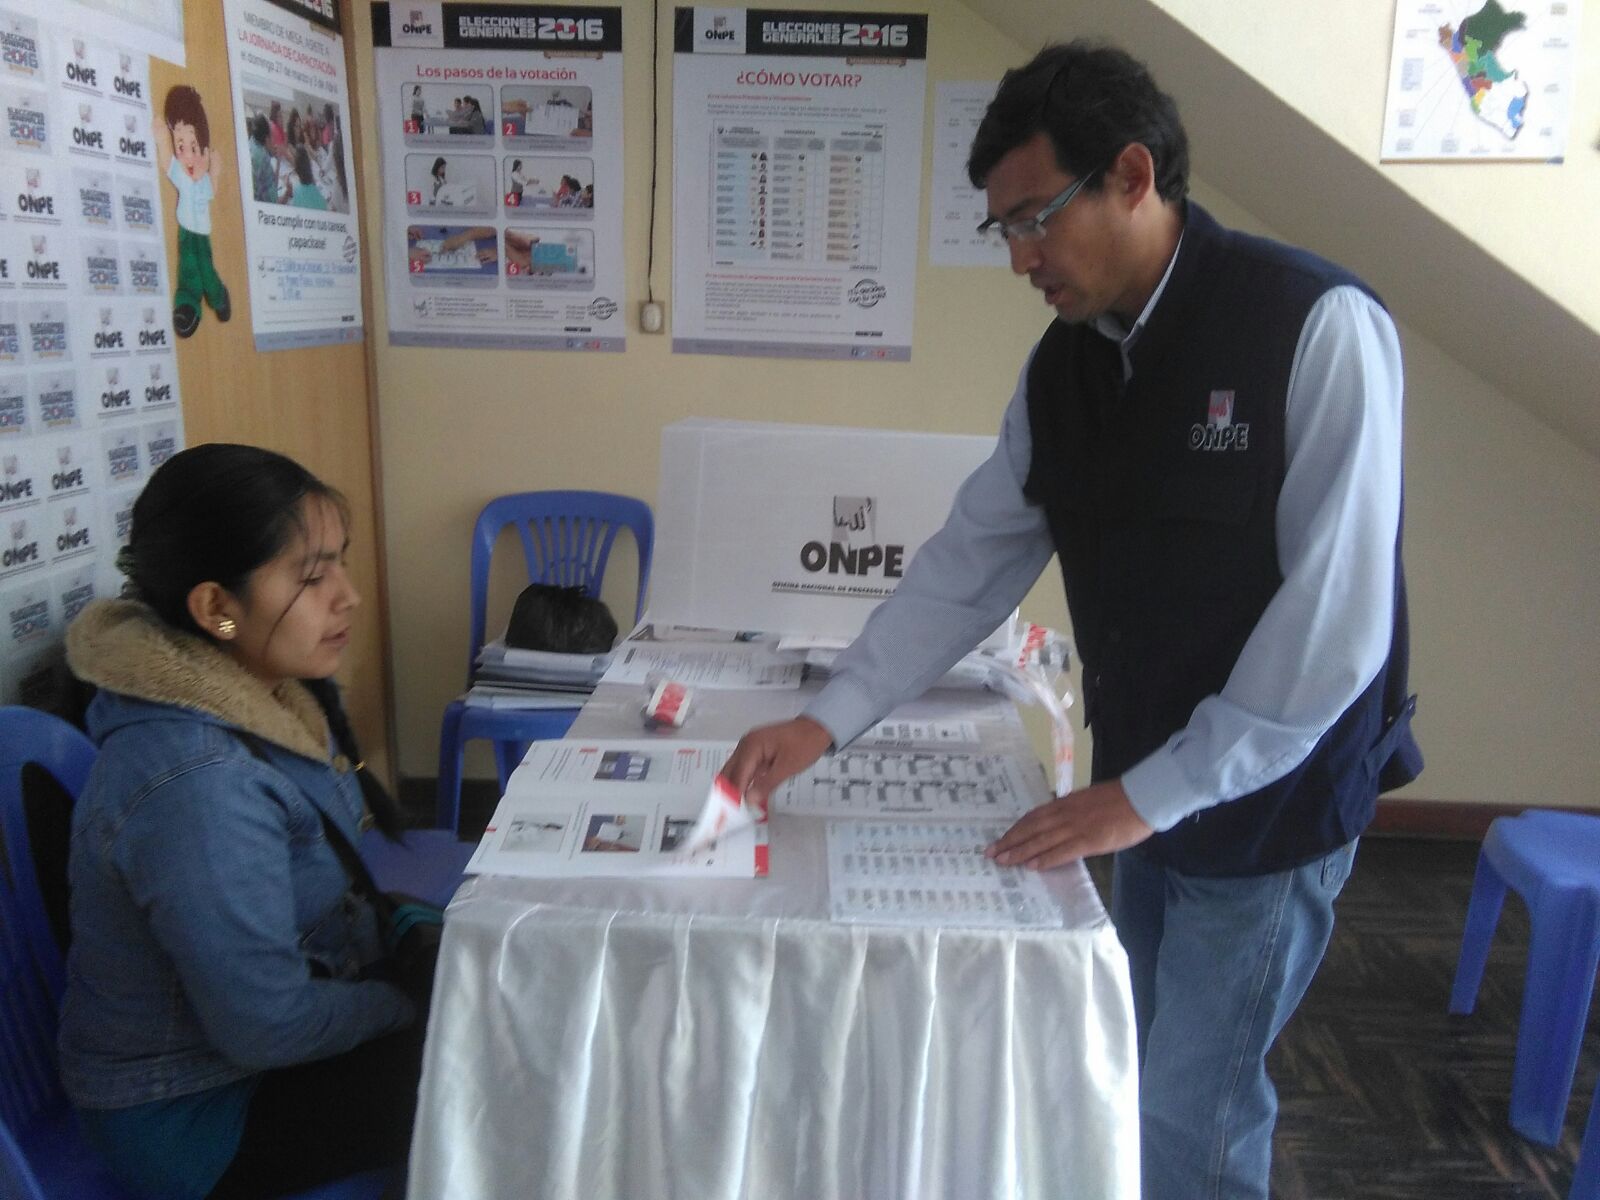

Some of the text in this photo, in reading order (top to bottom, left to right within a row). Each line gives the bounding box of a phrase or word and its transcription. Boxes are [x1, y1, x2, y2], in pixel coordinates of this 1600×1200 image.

[402, 23, 432, 34] ONPE
[459, 16, 536, 28] ELECCIONES
[459, 26, 536, 39] GENERALES
[538, 17, 604, 41] 2016
[762, 21, 840, 34] ELECCIONES
[249, 32, 281, 54] JORNADA
[705, 29, 735, 41] ONPE
[762, 31, 840, 44] GENERALES
[841, 23, 909, 47] 2016
[3, 47, 39, 69] 2016
[66, 62, 97, 87] ONPE
[416, 65, 577, 81] Los pasos de la votación
[736, 69, 862, 88] ¿CÓMO VOTAR?
[114, 76, 141, 98] ONPE
[9, 122, 46, 142] 2016
[73, 127, 103, 149] ONPE
[119, 137, 147, 158] ONPE
[18, 194, 54, 215] ONPE
[257, 209, 276, 224] Para
[277, 213, 303, 231] cumplir
[304, 217, 316, 228] con
[27, 260, 60, 279] ONPE
[95, 331, 124, 348] ONPE
[139, 329, 166, 345] ONPE
[102, 389, 131, 408] ONPE
[144, 384, 171, 402] ONPE
[1188, 423, 1250, 451] ONPE
[52, 468, 83, 490] ONPE
[57, 528, 88, 551] ONPE
[3, 541, 38, 567] ONPE
[800, 540, 904, 577] ONPE
